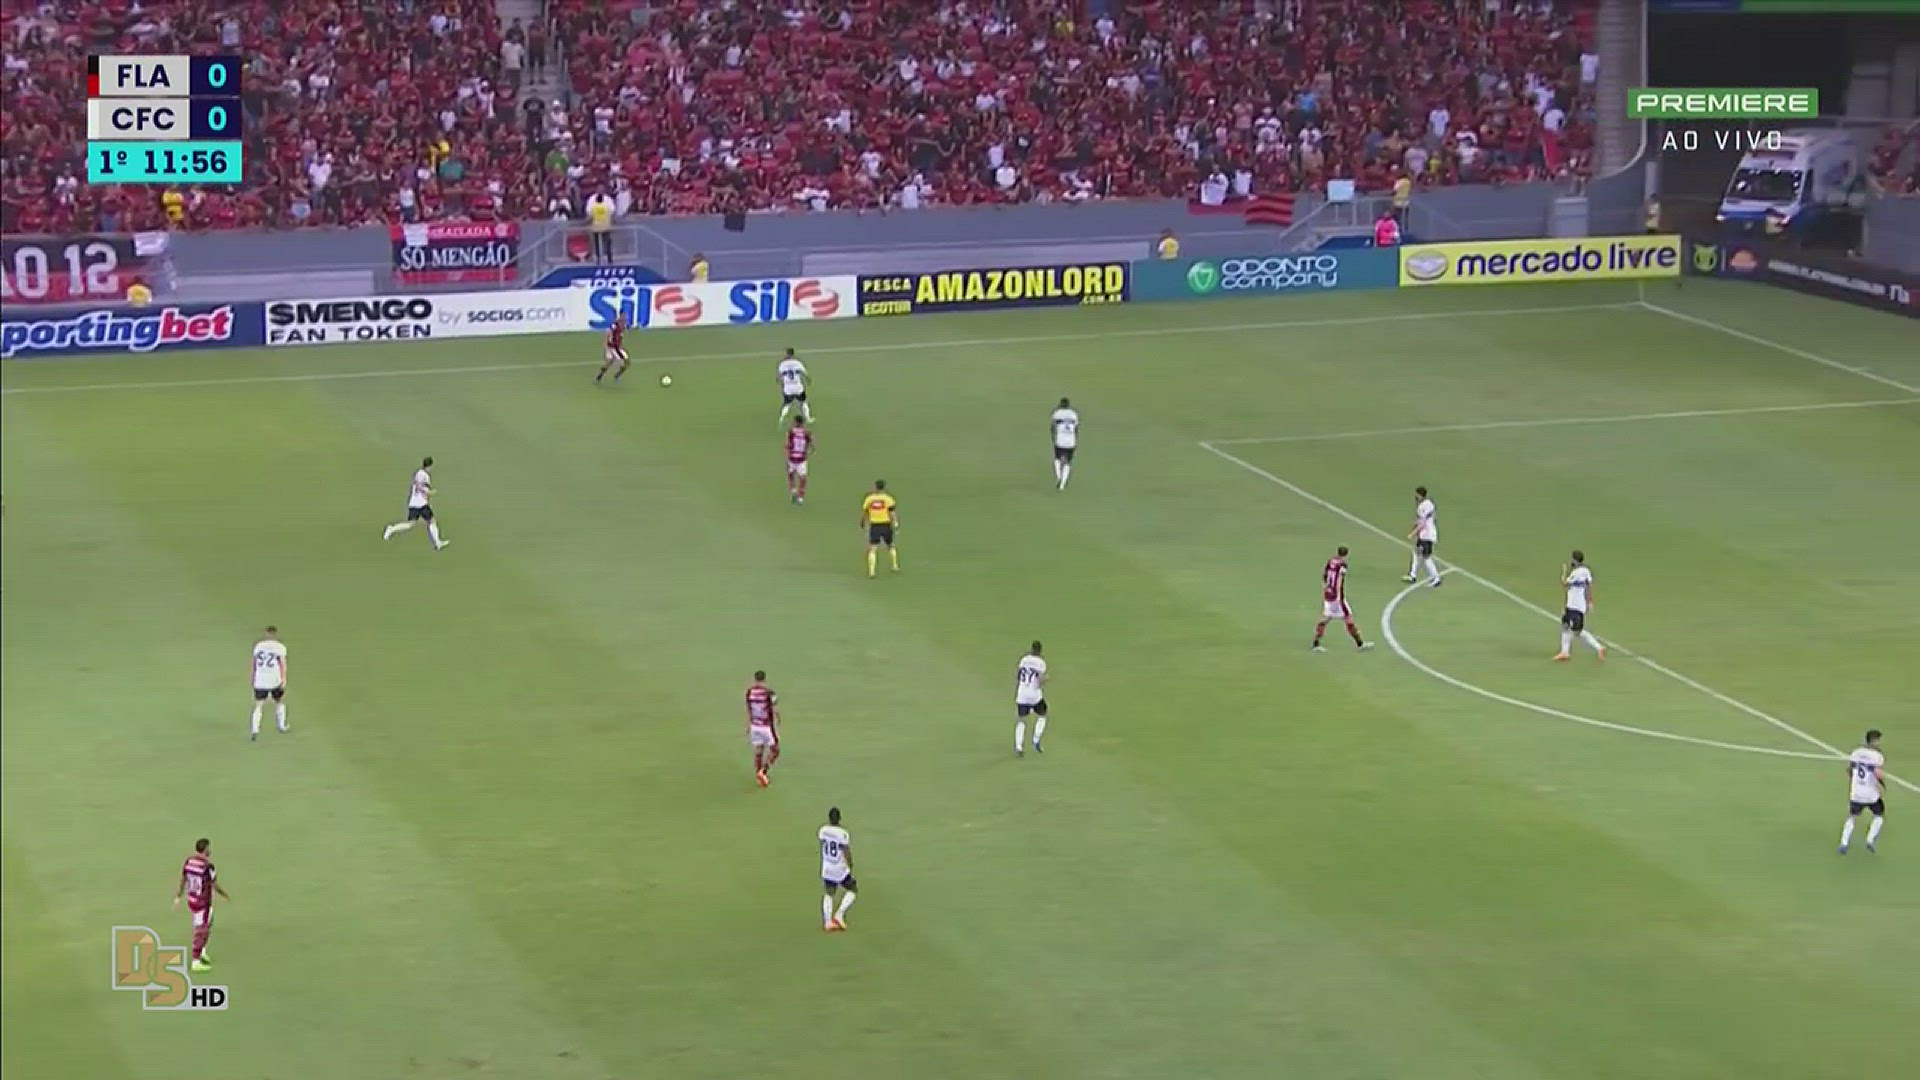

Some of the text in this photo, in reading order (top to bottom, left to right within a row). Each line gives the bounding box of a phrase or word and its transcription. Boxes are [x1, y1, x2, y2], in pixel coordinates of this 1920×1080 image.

[63, 241, 119, 297] 12
[431, 240, 510, 267] MENGÃO
[1222, 254, 1338, 276] ODONTO
[1456, 242, 1677, 276] mercado livre
[862, 277, 912, 293] PESCA
[915, 264, 1124, 305] AMAZONLORD
[438, 305, 462, 325] by
[588, 285, 653, 330] Sil
[727, 279, 791, 325] Sil
[1, 303, 235, 359] portingbet
[269, 323, 432, 344] FAN TOKEN
